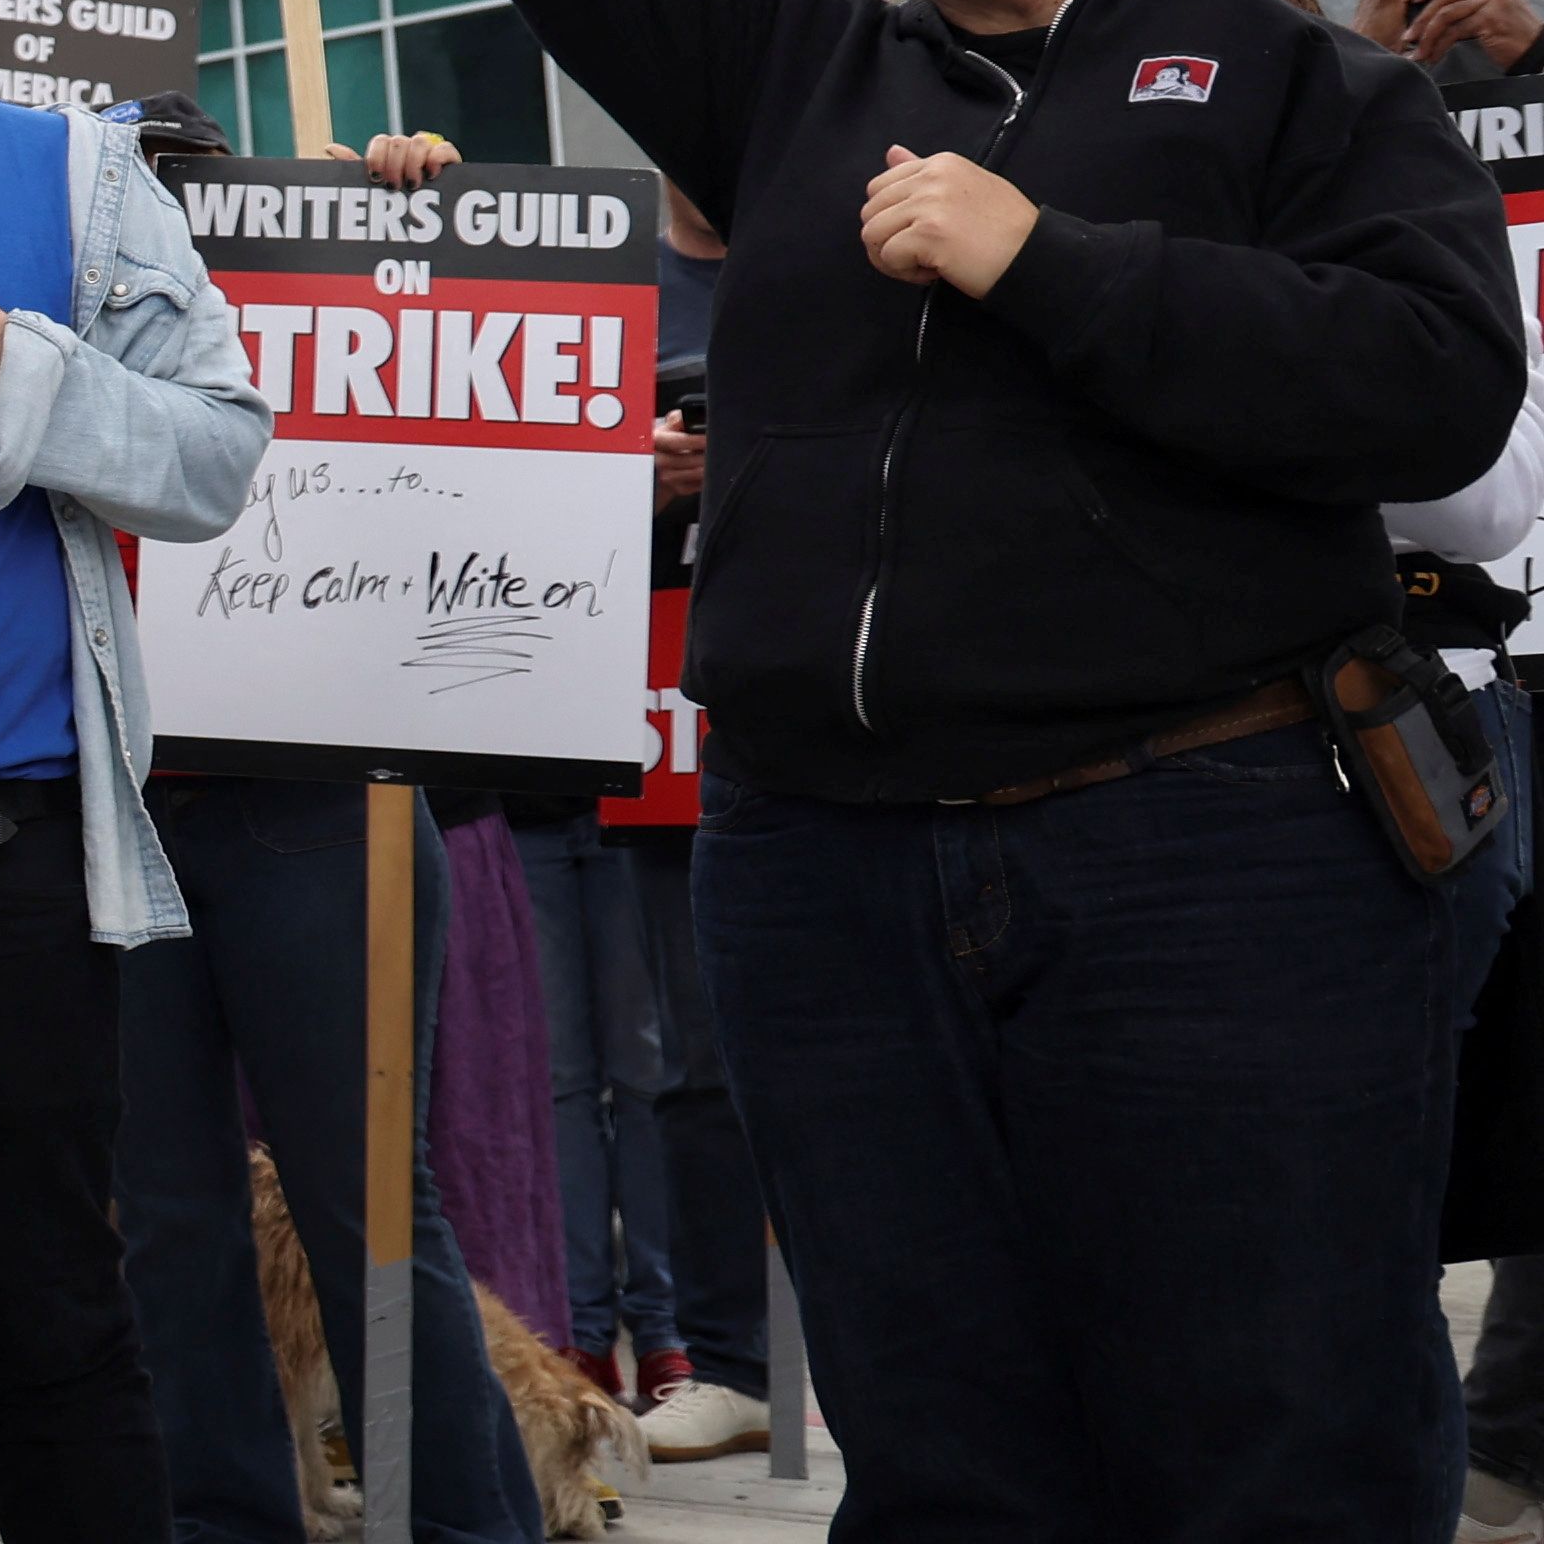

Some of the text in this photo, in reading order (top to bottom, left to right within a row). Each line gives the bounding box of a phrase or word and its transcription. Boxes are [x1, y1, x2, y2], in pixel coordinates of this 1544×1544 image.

[13, 33, 56, 63] OF
[184, 182, 632, 250] WRITERS GUILD
[374, 259, 431, 296] ON
[234, 303, 626, 430] TRIKE!
[196, 546, 290, 620] Keep
[427, 550, 536, 616] Write
